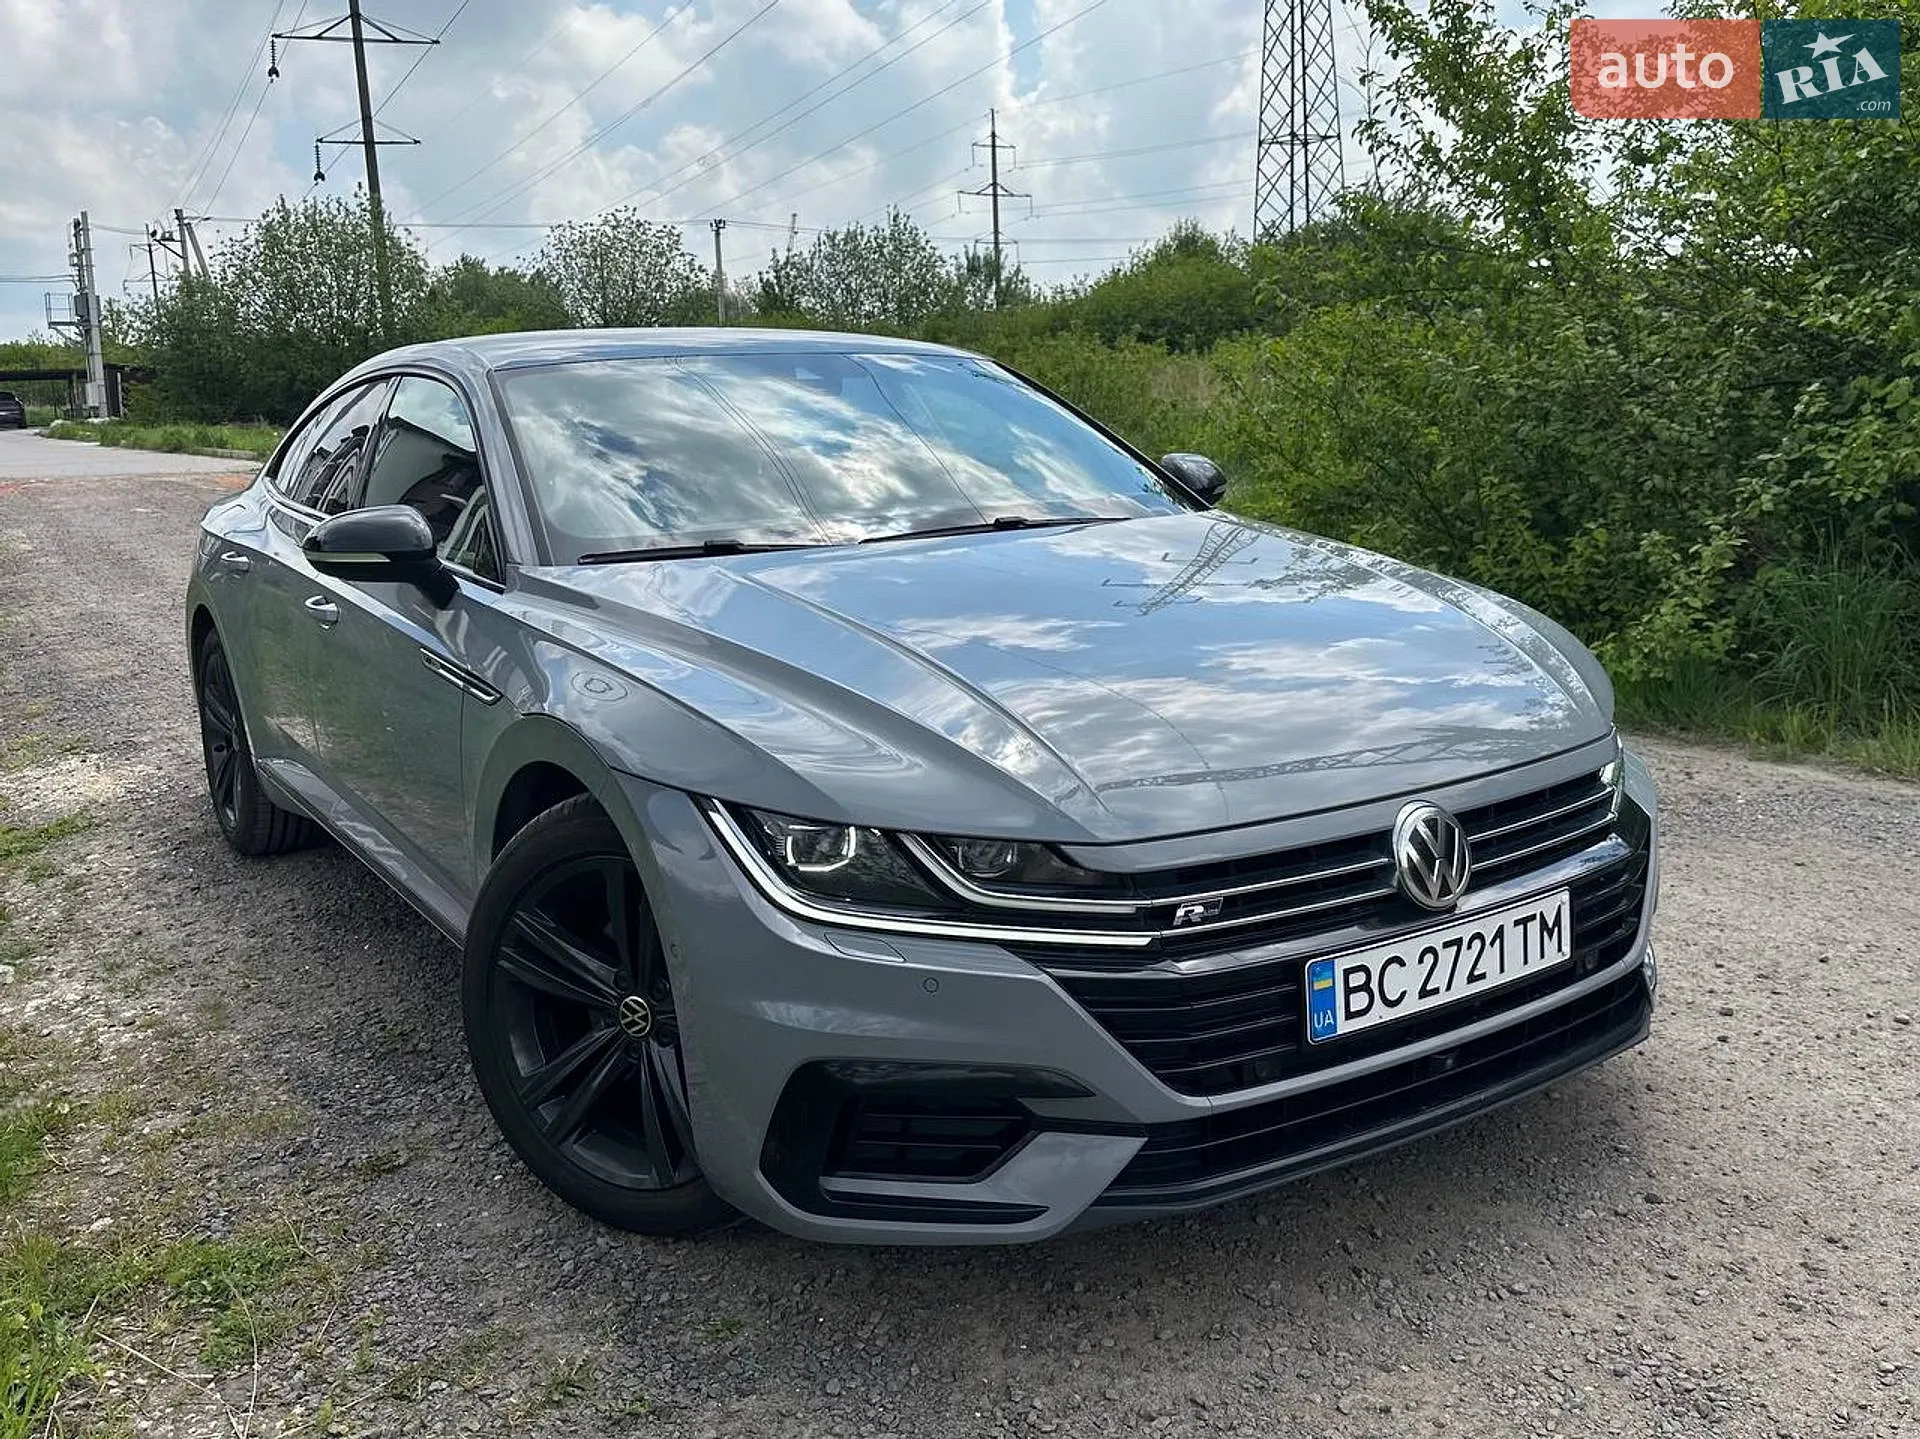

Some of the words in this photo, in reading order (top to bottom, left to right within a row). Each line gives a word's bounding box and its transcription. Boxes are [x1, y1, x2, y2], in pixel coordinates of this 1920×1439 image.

[1342, 955, 1407, 1021] BC
[1417, 924, 1505, 1000] 2721
[1513, 903, 1563, 966] TM
[1314, 1009, 1334, 1029] UA
